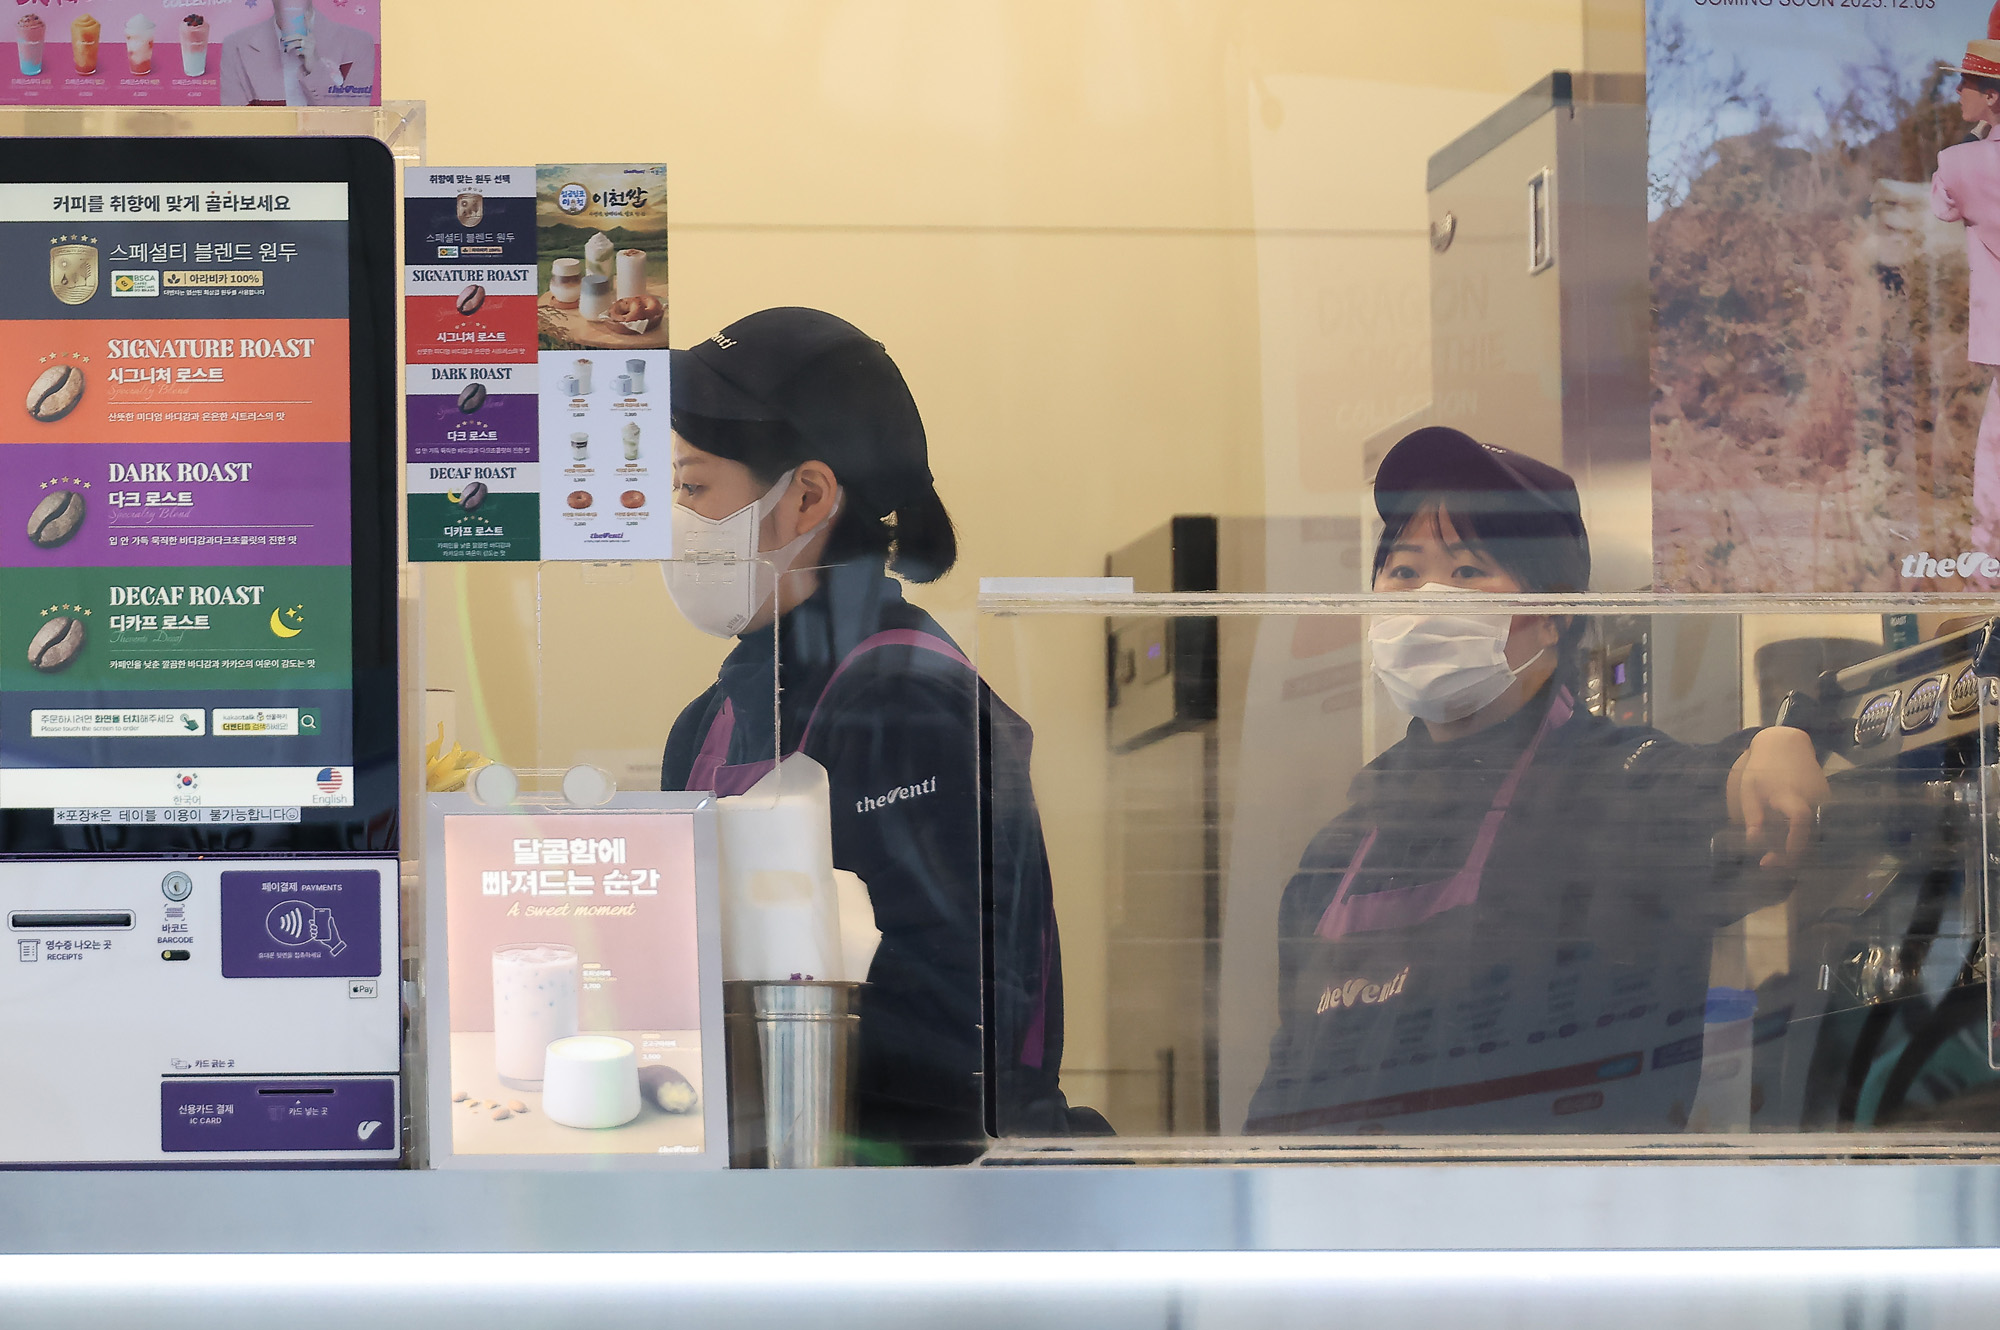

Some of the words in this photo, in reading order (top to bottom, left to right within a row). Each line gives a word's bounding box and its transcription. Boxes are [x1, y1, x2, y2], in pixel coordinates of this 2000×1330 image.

[429, 174, 455, 184] 취향에
[456, 174, 473, 184] 맞는
[475, 174, 492, 184] 원두
[494, 174, 511, 184] 선택
[592, 186, 649, 209] 이천쌀
[53, 195, 104, 213] 커피를
[109, 195, 160, 213] 취향에
[166, 195, 200, 212] 맞게
[205, 195, 291, 213] 골라보세요
[426, 233, 463, 244] 스페셜티
[466, 233, 494, 244] 블렌드
[496, 232, 515, 243] 원두
[109, 242, 188, 263] 스페셜티
[193, 242, 253, 263] 블렌드
[258, 242, 298, 263] 원두
[189, 274, 228, 284] 아라비카
[230, 274, 260, 284] 100%
[412, 269, 484, 281] SIGNATURE
[487, 269, 529, 281] ROAST
[436, 332, 475, 343] 시그니처
[477, 332, 507, 342] 로스트
[106, 339, 234, 359] SIGNATURE
[240, 339, 315, 358] ROAST
[108, 367, 172, 384] 시그니처
[176, 367, 225, 383] 로스트
[431, 368, 467, 380] DARK
[470, 368, 512, 380] ROAST
[108, 412, 134, 422] 산뜻한
[137, 412, 162, 422] 미디엄
[165, 412, 199, 422] 바디감과
[202, 412, 228, 422] 은은한
[230, 411, 274, 421] 시트러스의
[276, 411, 286, 421] 맛
[447, 431, 467, 441] 다크
[469, 431, 498, 441] 로스트
[108, 462, 172, 483] DARK
[177, 462, 252, 482] ROAST
[430, 467, 472, 479] DECAF
[475, 467, 517, 479] ROAST
[108, 491, 141, 508] 다크
[145, 491, 194, 507] 로스트
[444, 526, 473, 537] 디카프
[475, 526, 504, 536] 로스트
[109, 536, 118, 546] 입
[120, 536, 130, 546] 안
[131, 536, 149, 545] 가득
[151, 536, 178, 545] 묵직한
[268, 536, 287, 545] 진한
[288, 535, 297, 545] 맛
[1901, 551, 2000, 578] theVe
[109, 586, 184, 606] DECAF
[189, 585, 265, 606] ROAST
[109, 614, 158, 632] 디카프
[162, 614, 211, 630] 로스트
[109, 660, 142, 669] 카페인을
[144, 660, 160, 669] 낮춘
[162, 660, 186, 669] 깔끔한
[187, 660, 219, 669] 바디감과
[221, 659, 254, 669] 카카오의
[255, 659, 280, 669] 여운이
[281, 659, 306, 669] 감도는
[307, 659, 316, 669] 맛
[41, 714, 93, 724] 주문하시려면
[95, 714, 120, 723] 화면을
[122, 714, 175, 723] 터치해주세요
[223, 723, 251, 731] 더벤티를
[173, 795, 202, 806] 한국어
[312, 794, 347, 806] English
[119, 809, 157, 821] 테이블
[164, 809, 200, 821] 이용이
[209, 808, 286, 821] 불가능합니다
[513, 838, 627, 864] 달콤함에
[262, 882, 298, 892] 페이결제
[481, 870, 595, 896] 빠져드는
[602, 869, 660, 896] 순간
[506, 902, 521, 917] A
[525, 902, 572, 917] sweet
[573, 902, 638, 917] moment
[162, 923, 189, 934] 바코드
[45, 940, 72, 950] 영수증
[74, 940, 100, 950] 나오는
[103, 940, 112, 950] 곳
[359, 985, 374, 994] Pay
[195, 1059, 209, 1068] 카드
[227, 1059, 235, 1068] 곳
[178, 1104, 213, 1115] 신용카드
[216, 1104, 234, 1115] 결제
[289, 1107, 303, 1116] 카드
[320, 1107, 328, 1115] 곳
